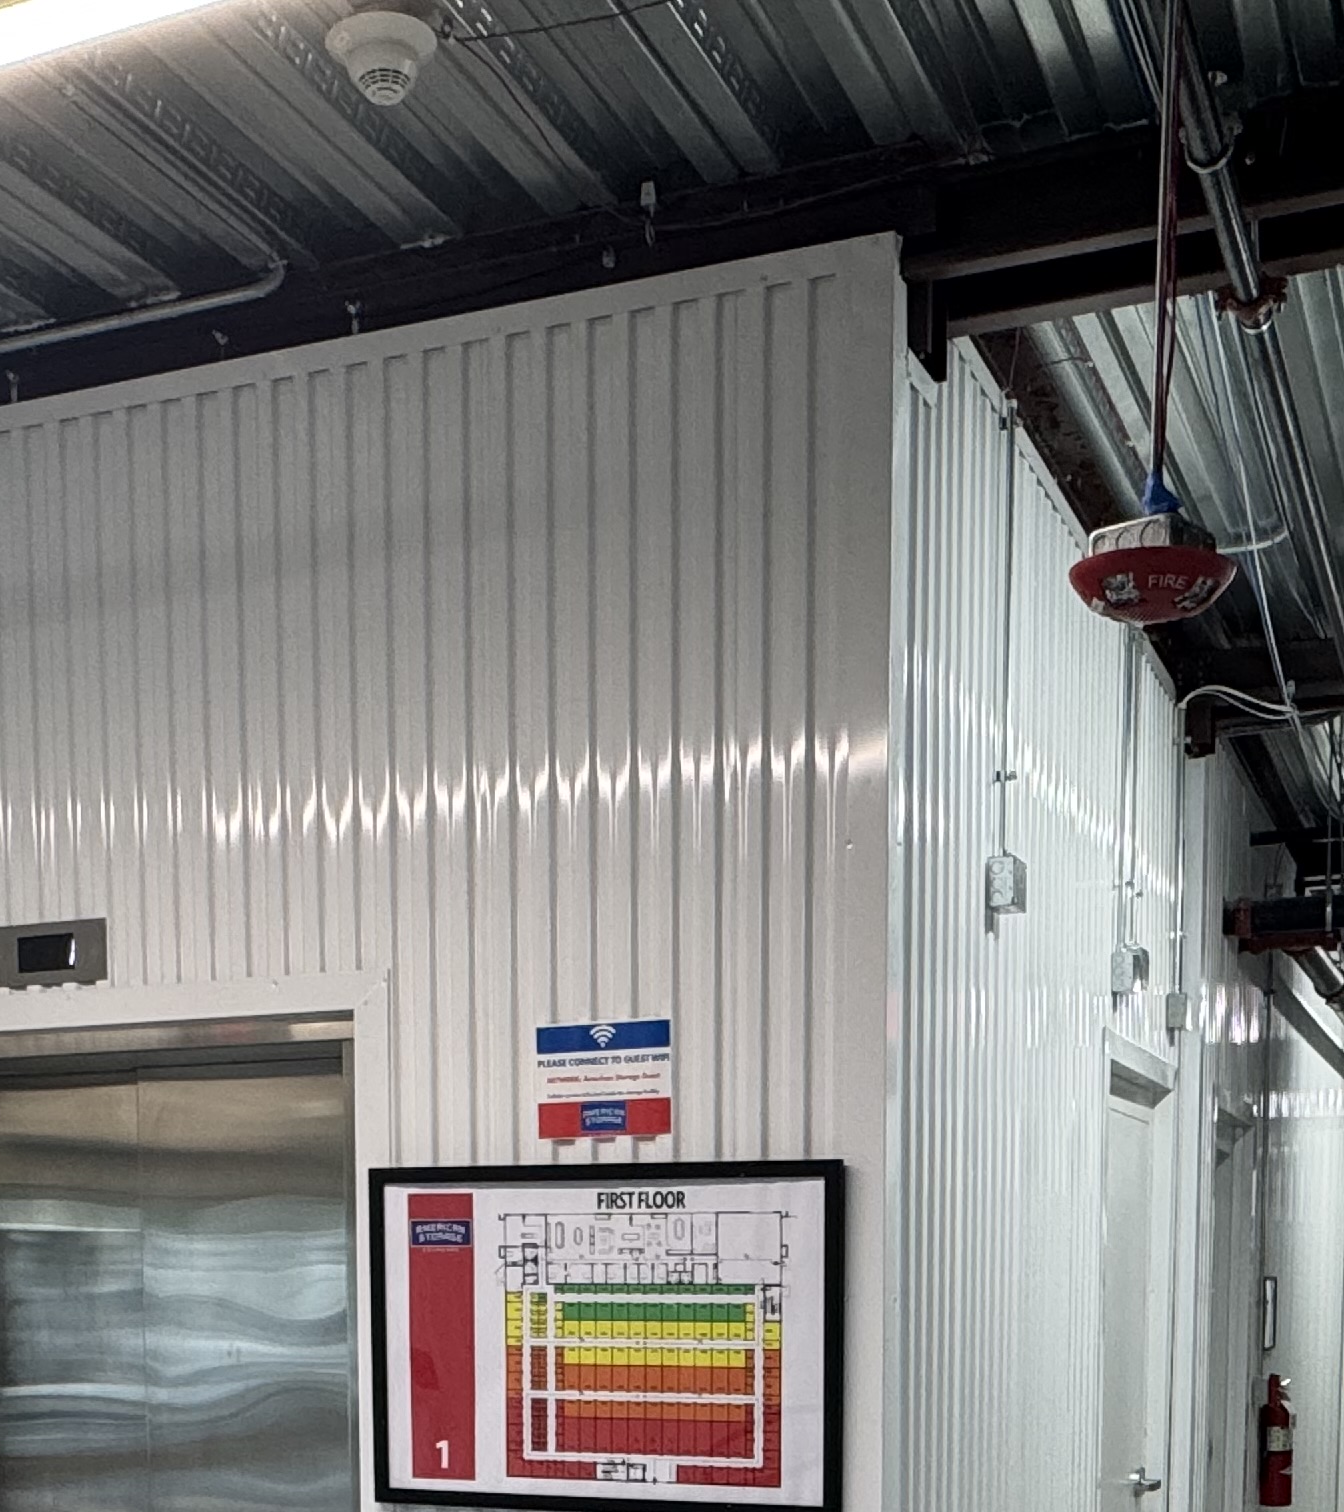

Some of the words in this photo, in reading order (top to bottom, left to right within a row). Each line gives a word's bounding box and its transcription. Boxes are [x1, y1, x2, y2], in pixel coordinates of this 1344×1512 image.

[1148, 573, 1189, 590] FIRE
[538, 1058, 567, 1068] PLEASE
[570, 1057, 609, 1067] CONNECT
[612, 1056, 621, 1064] TO
[624, 1055, 650, 1064] GUEST
[597, 1191, 636, 1210] FIRST
[637, 1191, 686, 1210] FLOOR
[436, 1440, 449, 1469] 1
